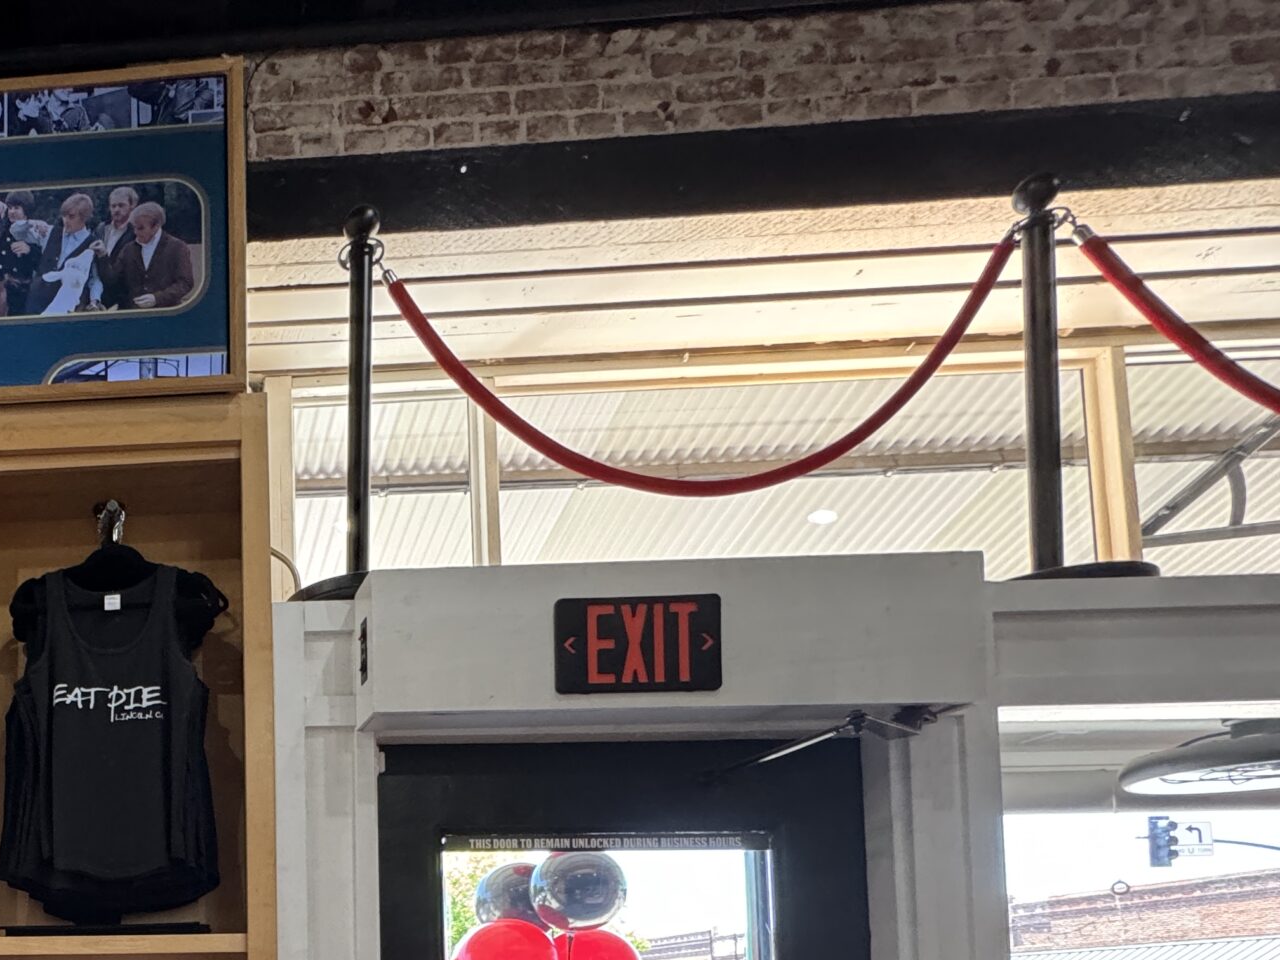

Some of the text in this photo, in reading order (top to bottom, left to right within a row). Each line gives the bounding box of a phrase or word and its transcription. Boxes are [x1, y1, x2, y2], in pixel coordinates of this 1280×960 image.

[587, 602, 699, 685] EXIT
[53, 683, 167, 723] EAT PIE
[469, 836, 742, 849] THIS DOOR TO REMAIN UNLOCKED DURING BUSINESS HOURS
